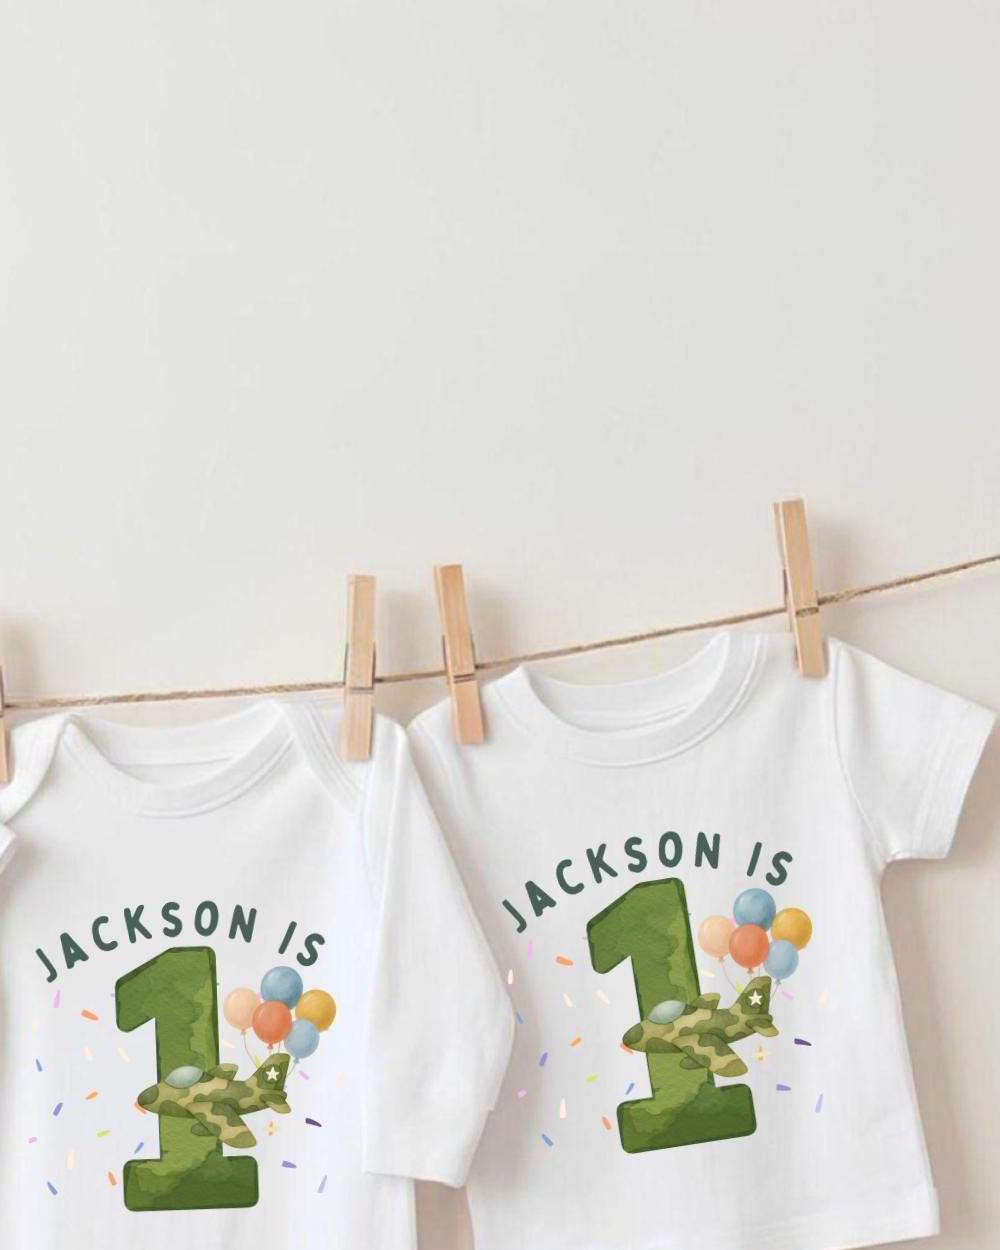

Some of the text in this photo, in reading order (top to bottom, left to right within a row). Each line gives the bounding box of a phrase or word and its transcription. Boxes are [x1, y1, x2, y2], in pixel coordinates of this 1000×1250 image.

[35, 901, 326, 982] JACKSON IS
[503, 831, 793, 933] JACKSON IS
[114, 946, 259, 1212] 1
[587, 877, 757, 1153] 1
